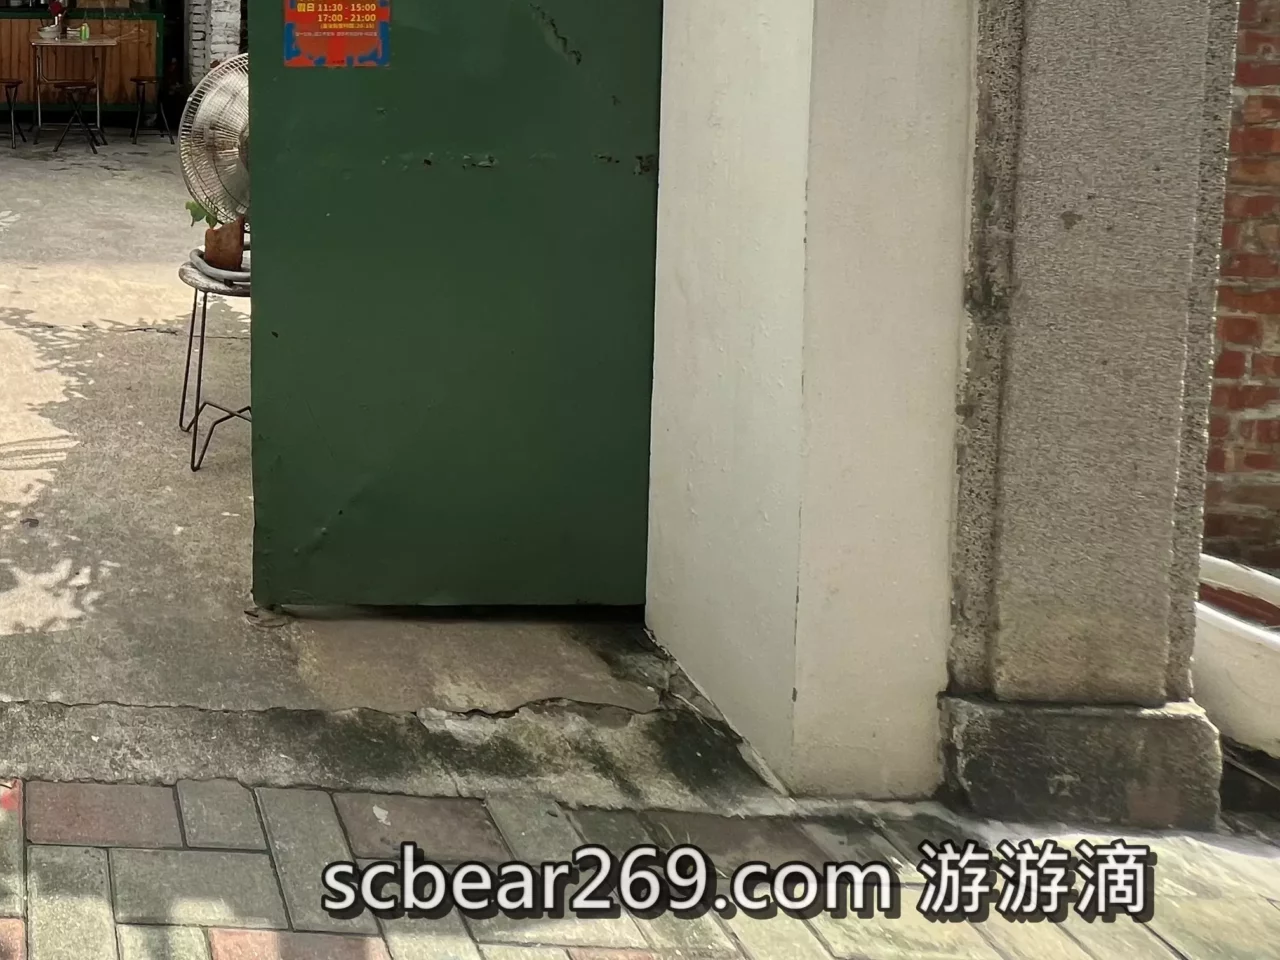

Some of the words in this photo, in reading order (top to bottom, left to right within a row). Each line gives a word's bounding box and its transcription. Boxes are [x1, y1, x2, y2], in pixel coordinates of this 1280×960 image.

[317, 3, 343, 12] 11:30
[350, 3, 376, 12] 15:00
[317, 14, 343, 22] 17:00
[350, 14, 376, 22] 21:00
